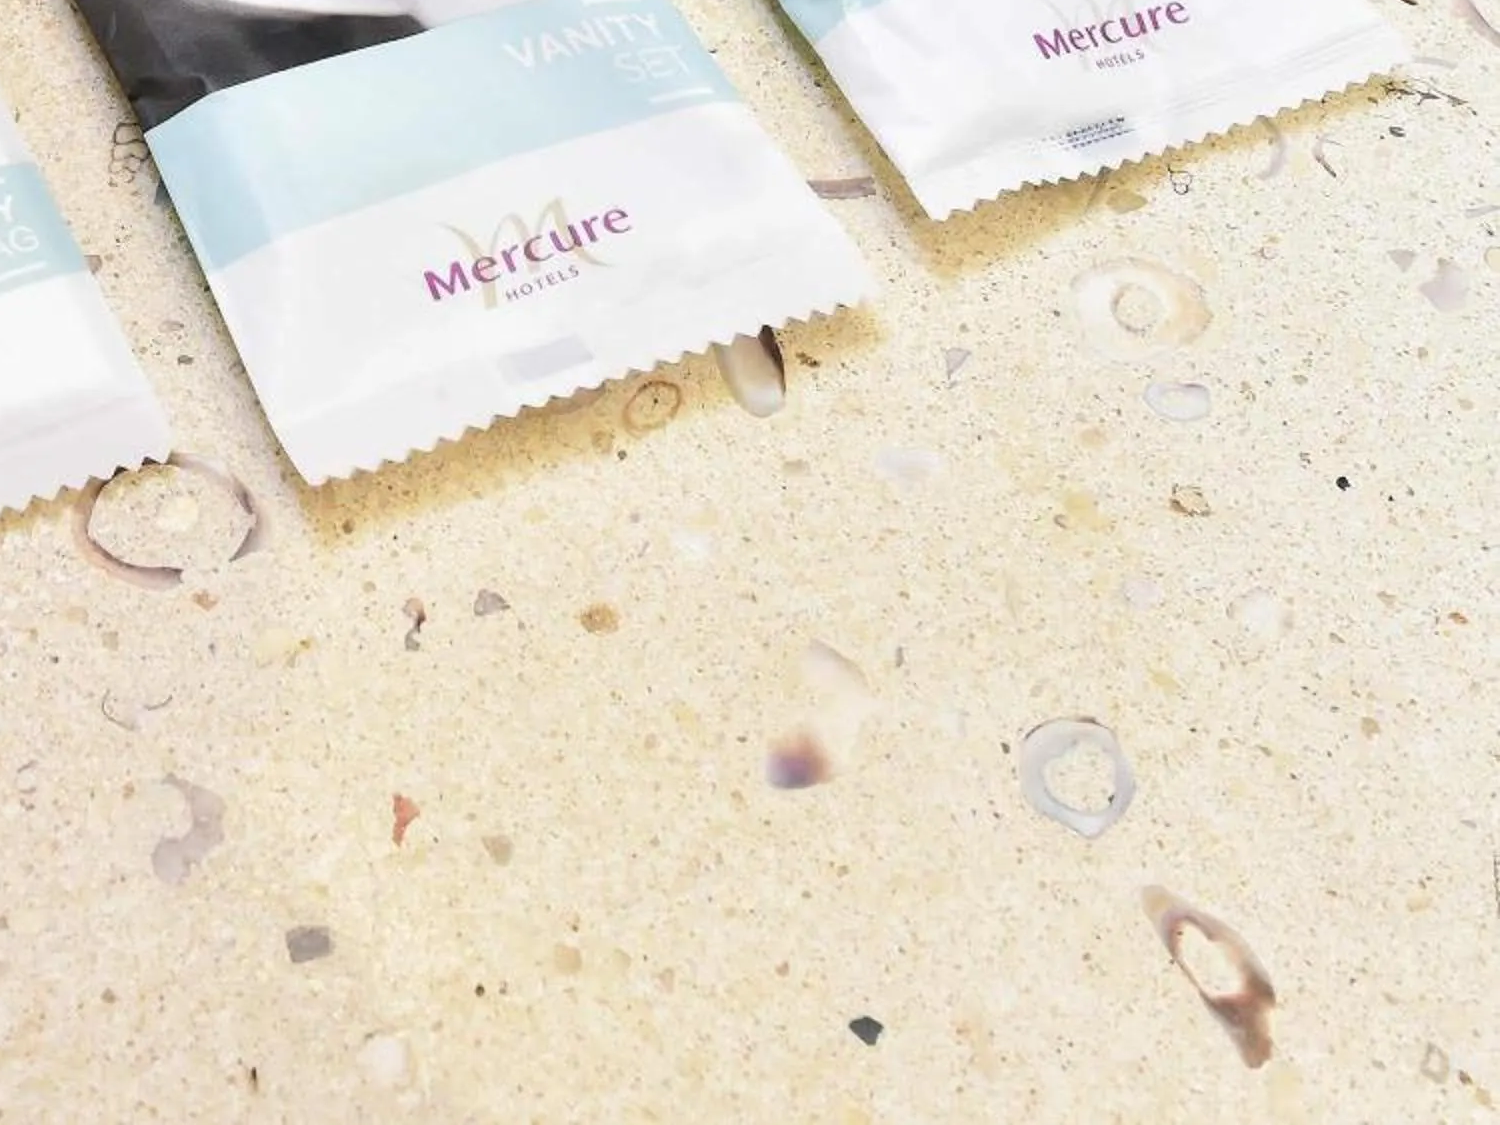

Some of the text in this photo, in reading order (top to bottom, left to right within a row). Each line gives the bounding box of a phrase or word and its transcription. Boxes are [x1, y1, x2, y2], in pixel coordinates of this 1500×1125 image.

[505, 12, 663, 67] VANITY
[1032, 0, 1190, 60] Mercure
[613, 43, 692, 83] SET
[1096, 48, 1145, 70] HOTELS
[423, 207, 632, 301] Mercure
[505, 264, 579, 302] HOTELS
